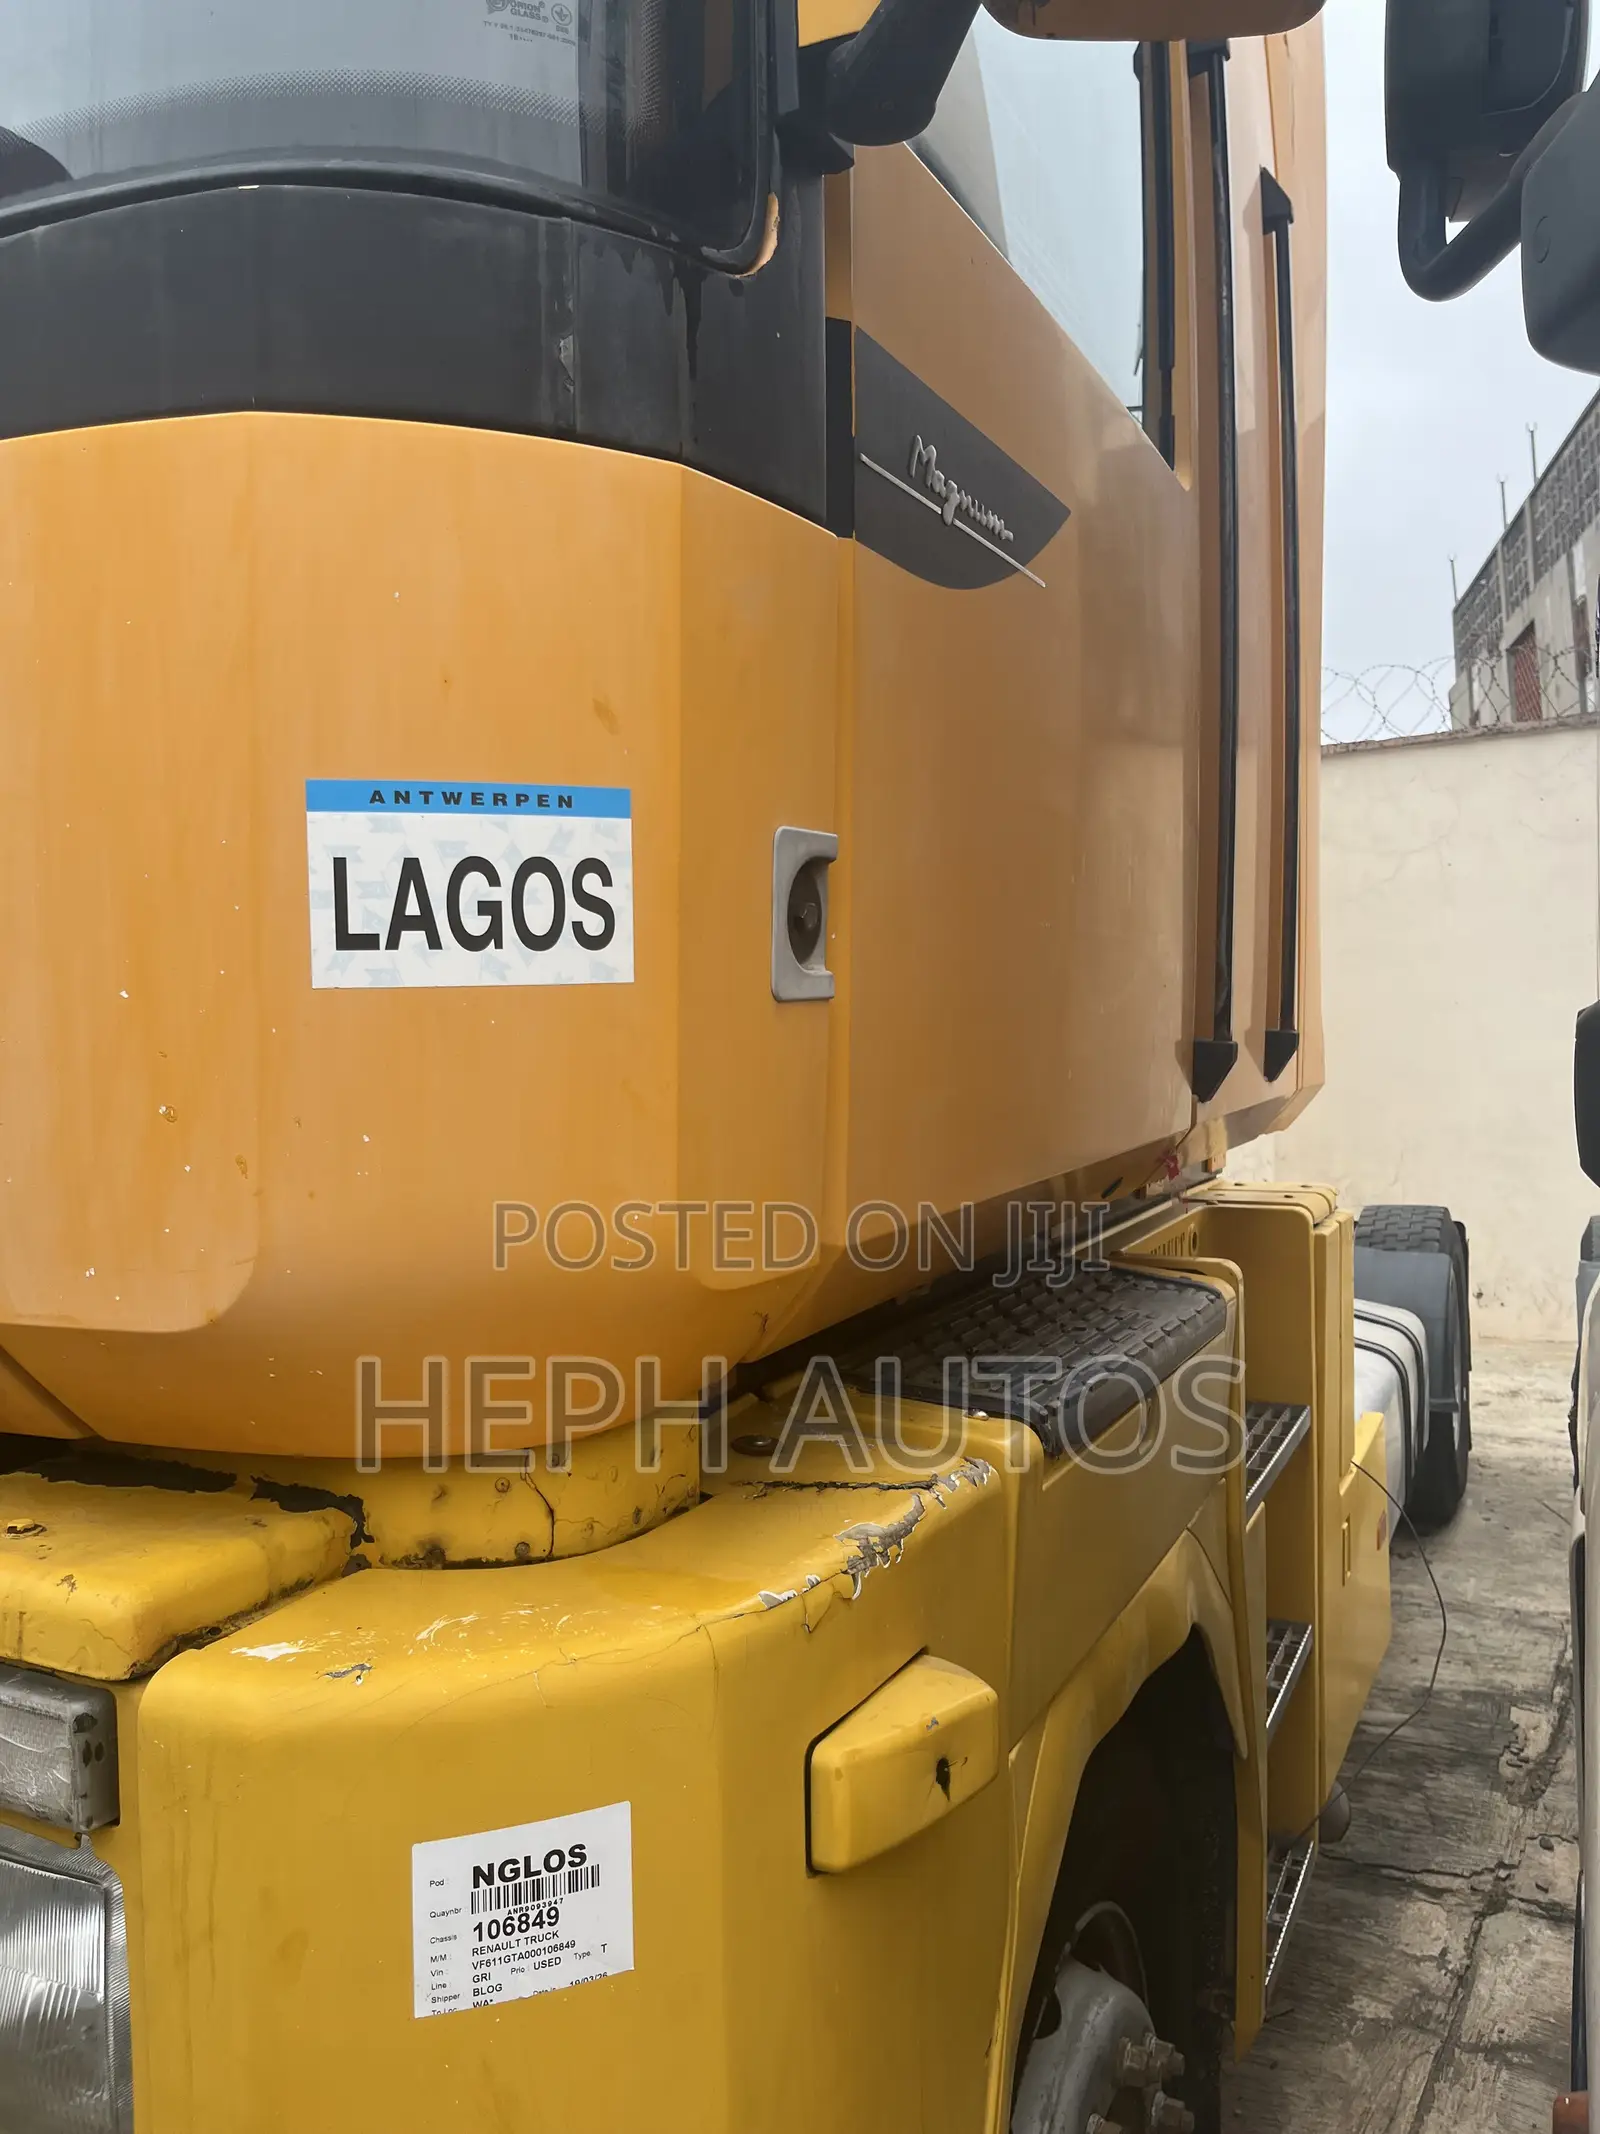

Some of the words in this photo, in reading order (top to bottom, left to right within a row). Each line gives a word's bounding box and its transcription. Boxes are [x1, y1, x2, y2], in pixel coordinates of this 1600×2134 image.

[510, 7, 541, 20] GLASS
[909, 434, 1014, 542] Magnum
[369, 790, 573, 809] ANTWERPEN
[333, 855, 616, 952] LAGOS
[429, 1879, 445, 1887] Pod
[473, 1843, 588, 1889] NGLOS
[429, 1907, 462, 1919] Quaynbr
[507, 1897, 564, 1916] ANR9093947
[429, 1933, 458, 1944] Chassis
[473, 1906, 560, 1942] 106849
[472, 1939, 521, 1957] RENAULT
[524, 1930, 560, 1946] TRUCK
[472, 1940, 576, 1970] VF611GTA000106849
[472, 1972, 491, 1984] GRI
[533, 1956, 562, 1971] USED
[601, 1943, 608, 1954] T
[431, 1993, 461, 2004] Shipper
[473, 1983, 503, 1997] BLOG
